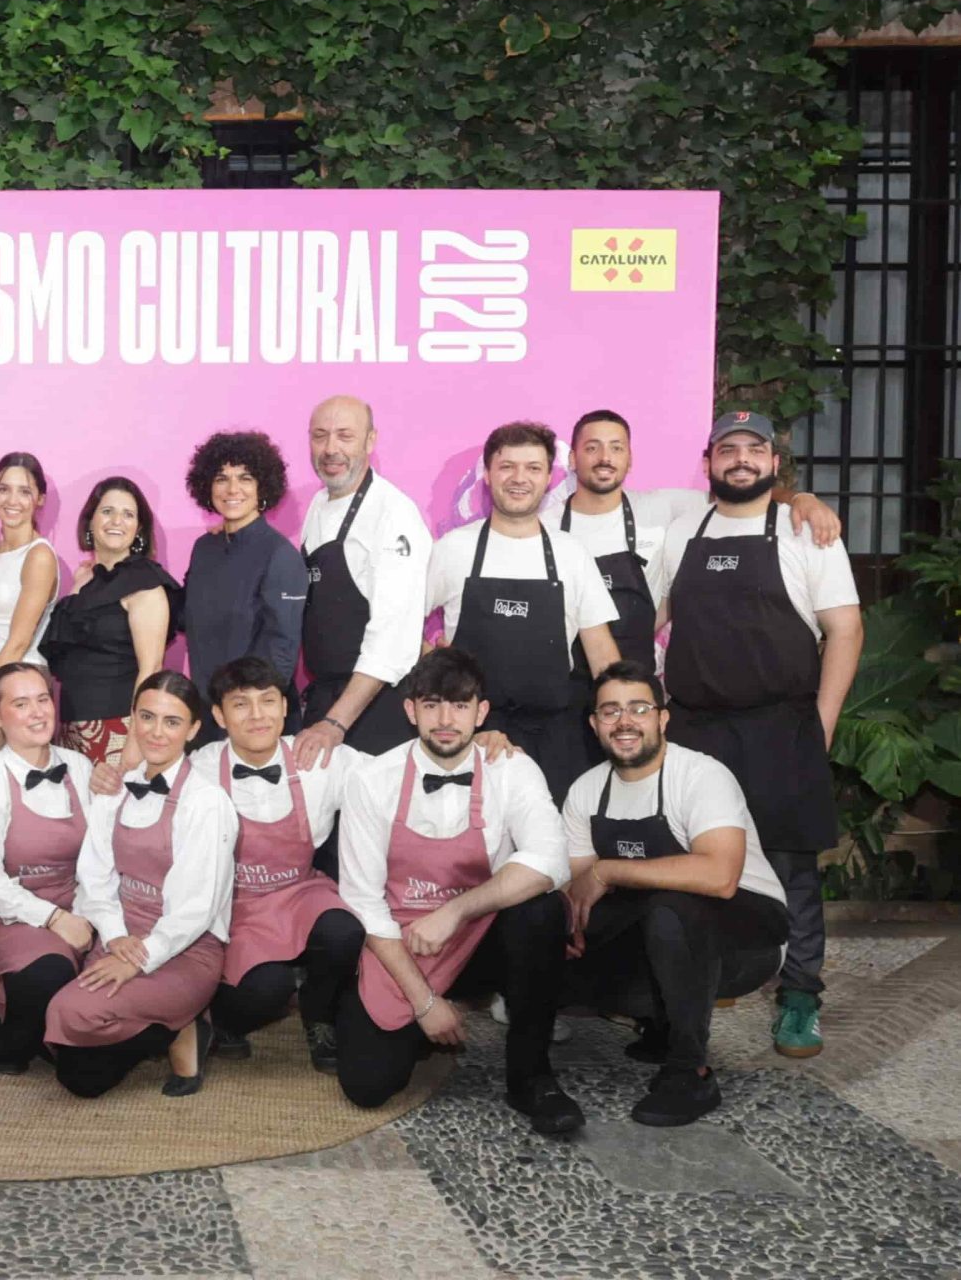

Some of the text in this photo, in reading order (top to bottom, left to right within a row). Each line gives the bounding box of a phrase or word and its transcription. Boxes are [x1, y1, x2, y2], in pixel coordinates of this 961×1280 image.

[579, 253, 668, 266] CATALUNYA
[119, 230, 408, 365] CULTURAL
[417, 229, 530, 363] 2026
